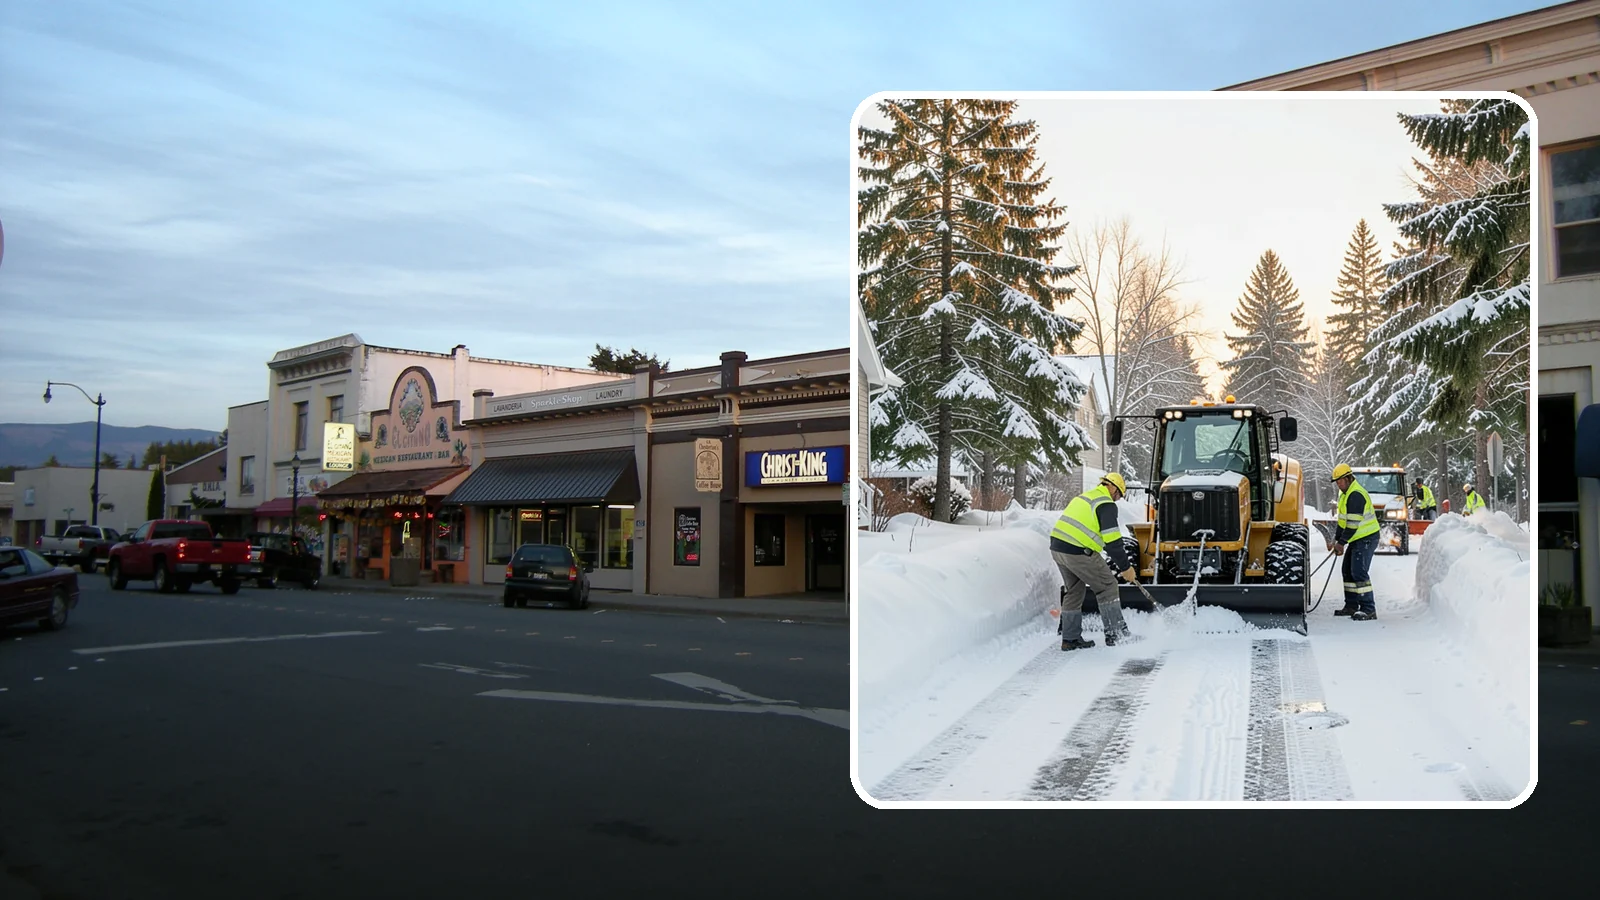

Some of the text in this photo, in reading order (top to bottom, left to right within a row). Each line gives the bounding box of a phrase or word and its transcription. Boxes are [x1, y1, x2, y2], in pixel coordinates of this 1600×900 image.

[596, 388, 624, 399] LAUNDRY
[493, 402, 522, 412] LAVANDERIA
[530, 394, 582, 409] Sparkle Shop
[373, 454, 396, 464] MEXICAN
[397, 451, 433, 462] RESTAURANT
[438, 450, 450, 459] BAR
[761, 450, 827, 478] CHRIST KING
